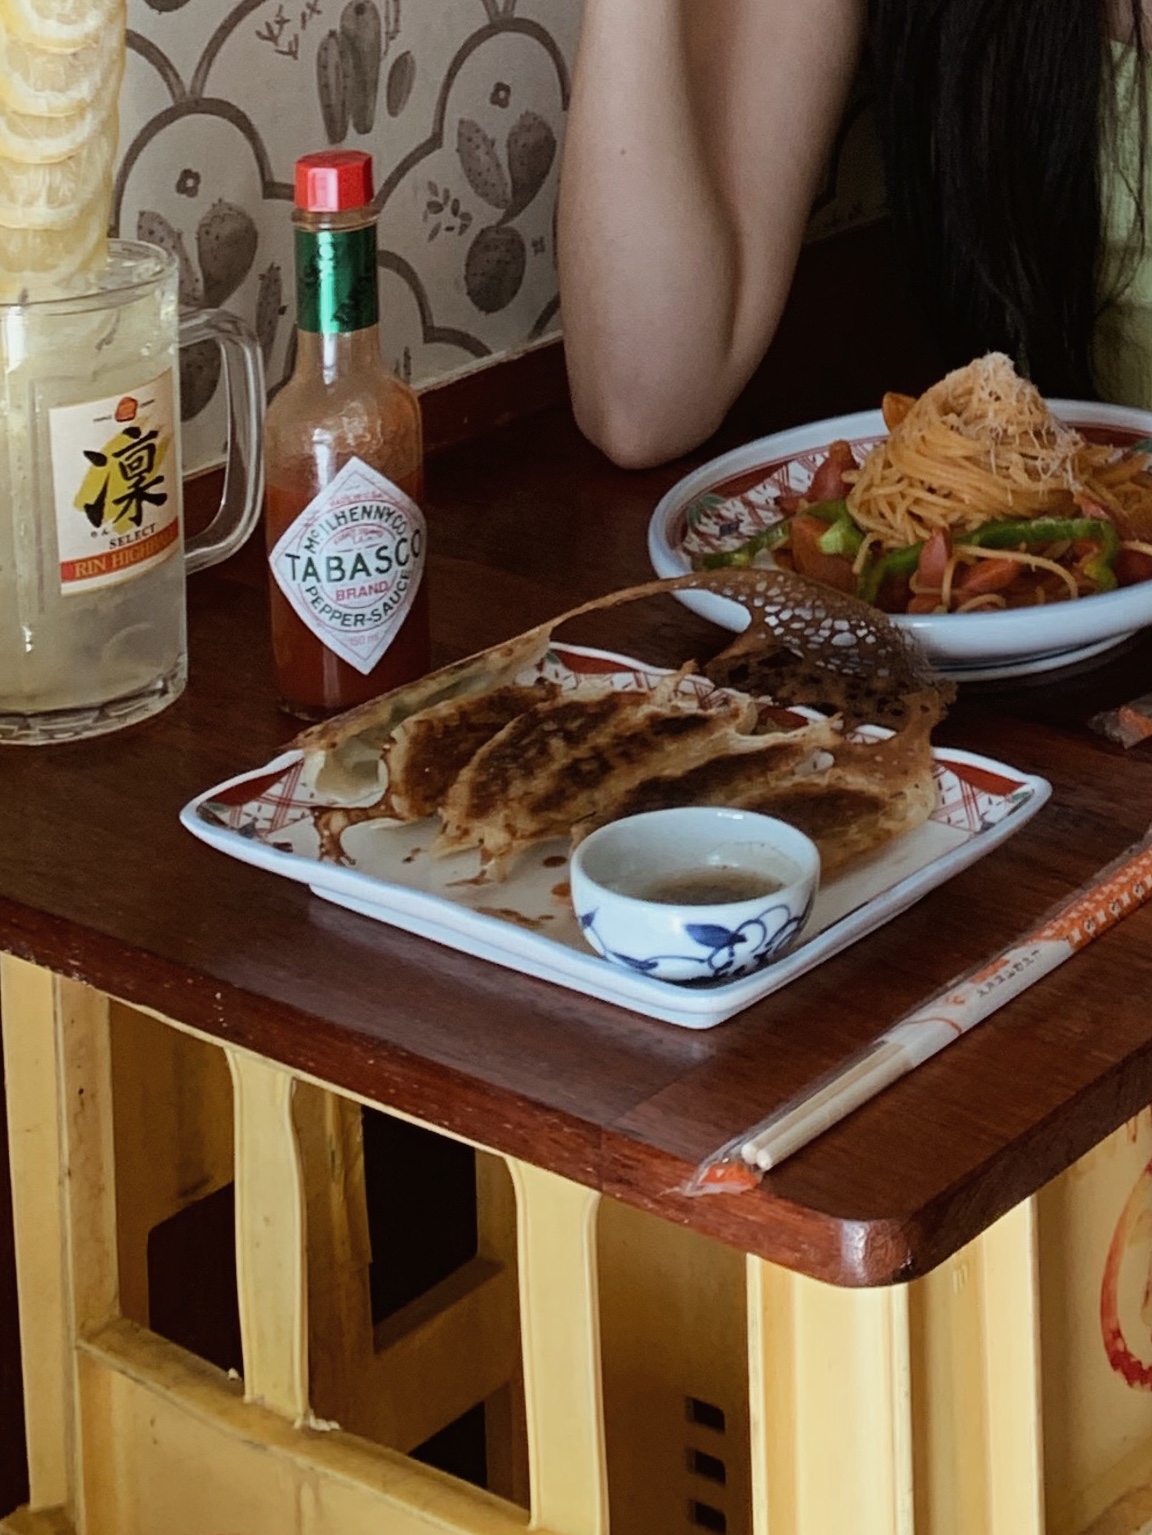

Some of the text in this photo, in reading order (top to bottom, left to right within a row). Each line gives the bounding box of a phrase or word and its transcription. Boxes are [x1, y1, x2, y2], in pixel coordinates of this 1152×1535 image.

[109, 522, 157, 550] SELECT
[74, 557, 107, 578] RIN
[285, 528, 421, 584] TABASCO
[304, 572, 410, 627] PEPPER-SAUCE
[335, 580, 389, 602] BRAND
